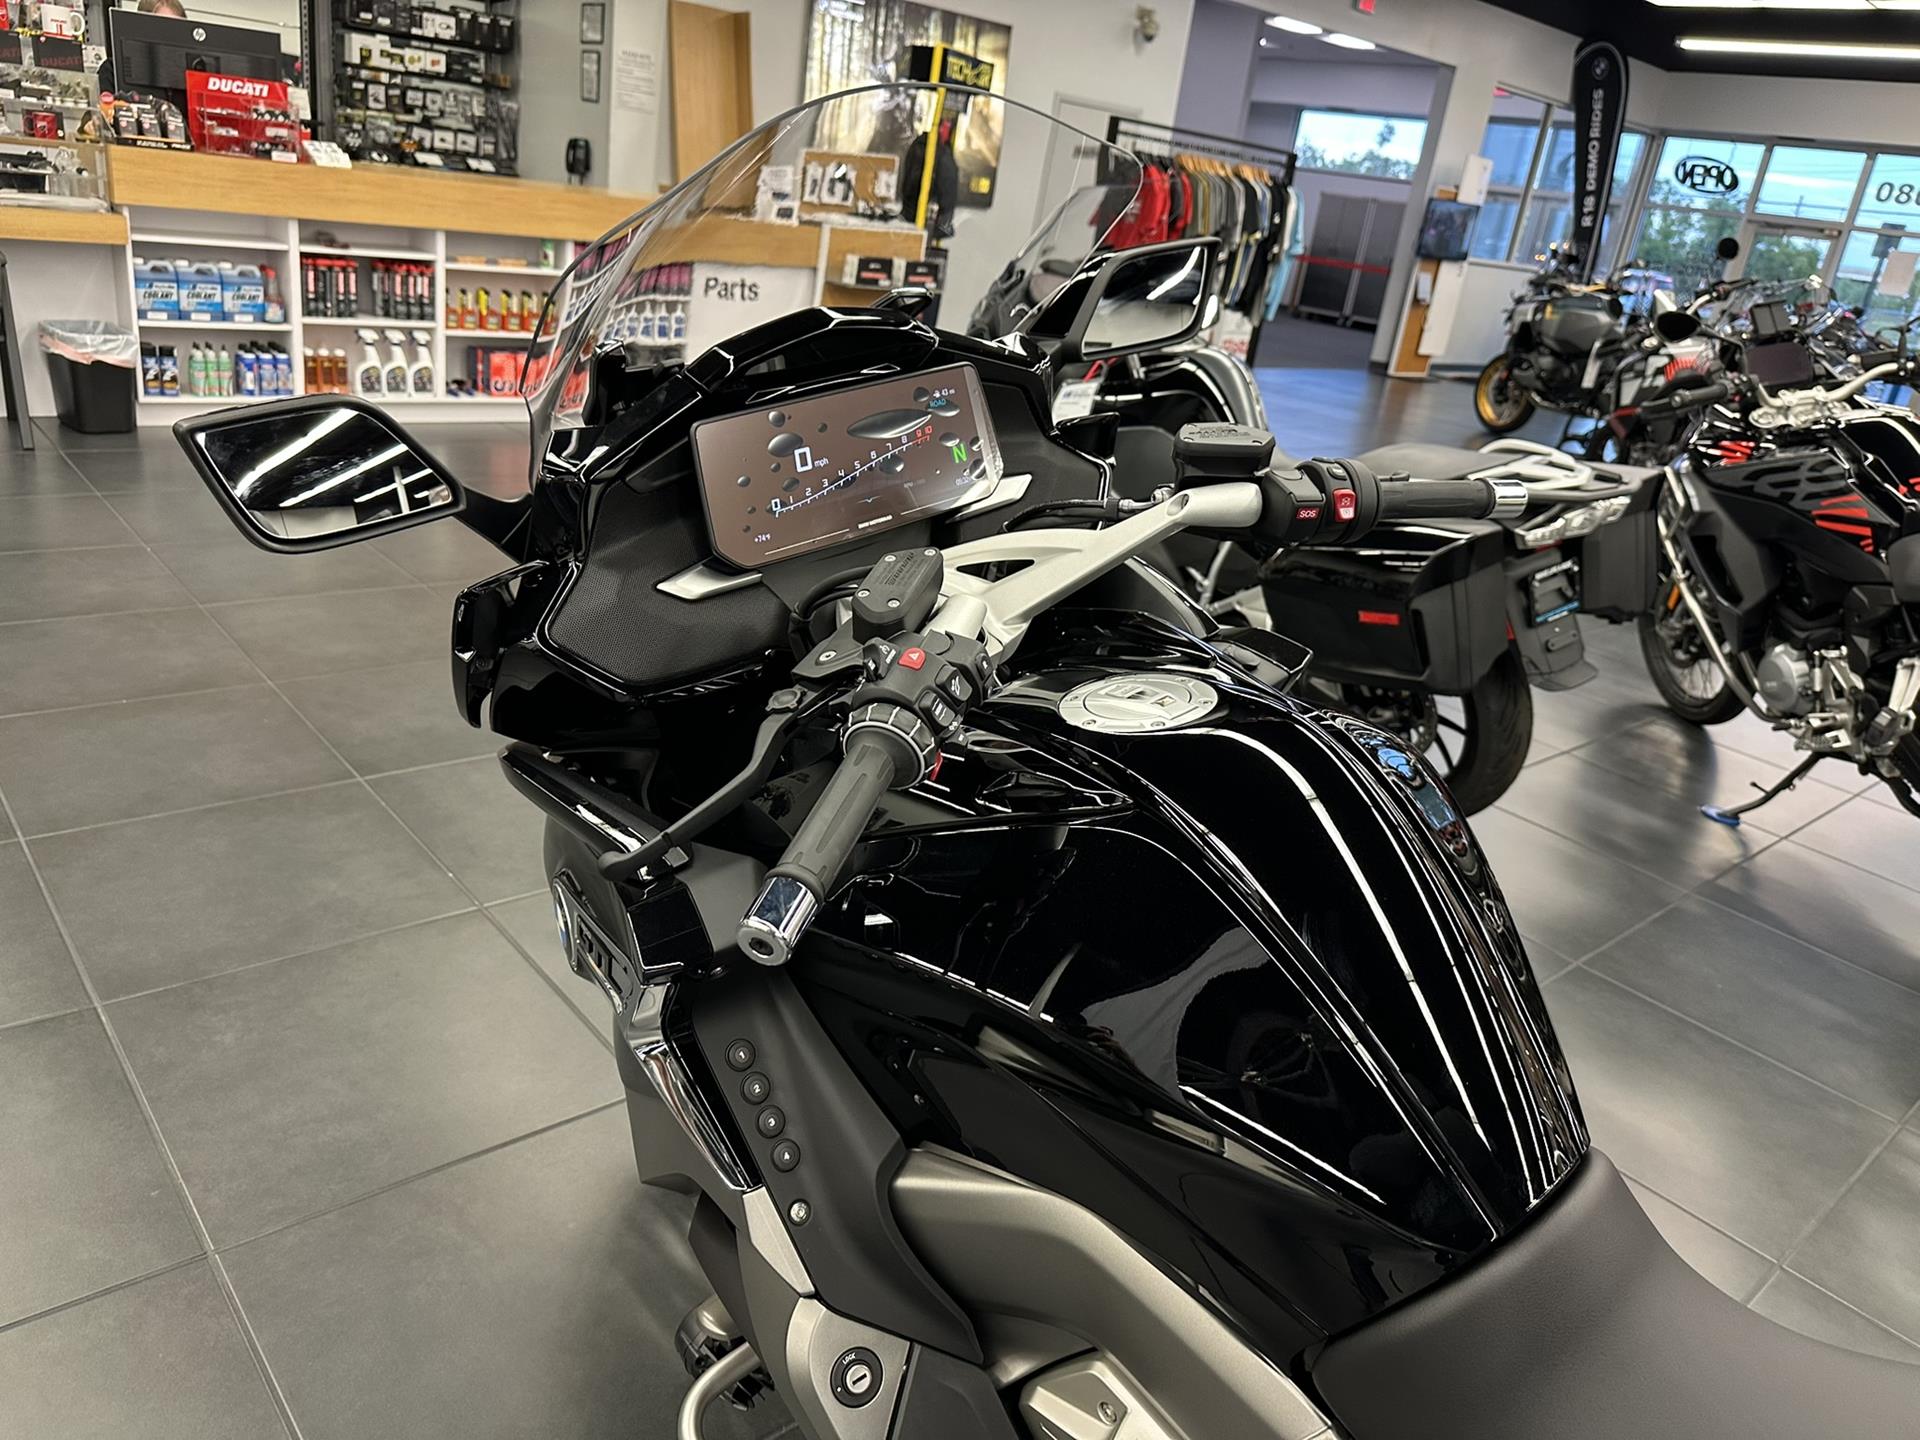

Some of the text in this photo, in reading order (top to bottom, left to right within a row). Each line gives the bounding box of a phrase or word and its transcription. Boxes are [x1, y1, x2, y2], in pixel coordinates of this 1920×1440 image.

[208, 77, 269, 97] DUCATI
[1589, 88, 1604, 138] RIDES
[1586, 140, 1600, 191] DEMO
[143, 290, 174, 300] COOLANT
[187, 291, 216, 300] COOLANT
[232, 292, 260, 301] COOLANT
[704, 277, 759, 300] Parts
[794, 446, 829, 473] 0 mph
[952, 442, 967, 464] N
[1299, 510, 1315, 518] SOS
[842, 1352, 856, 1365] LOCK
